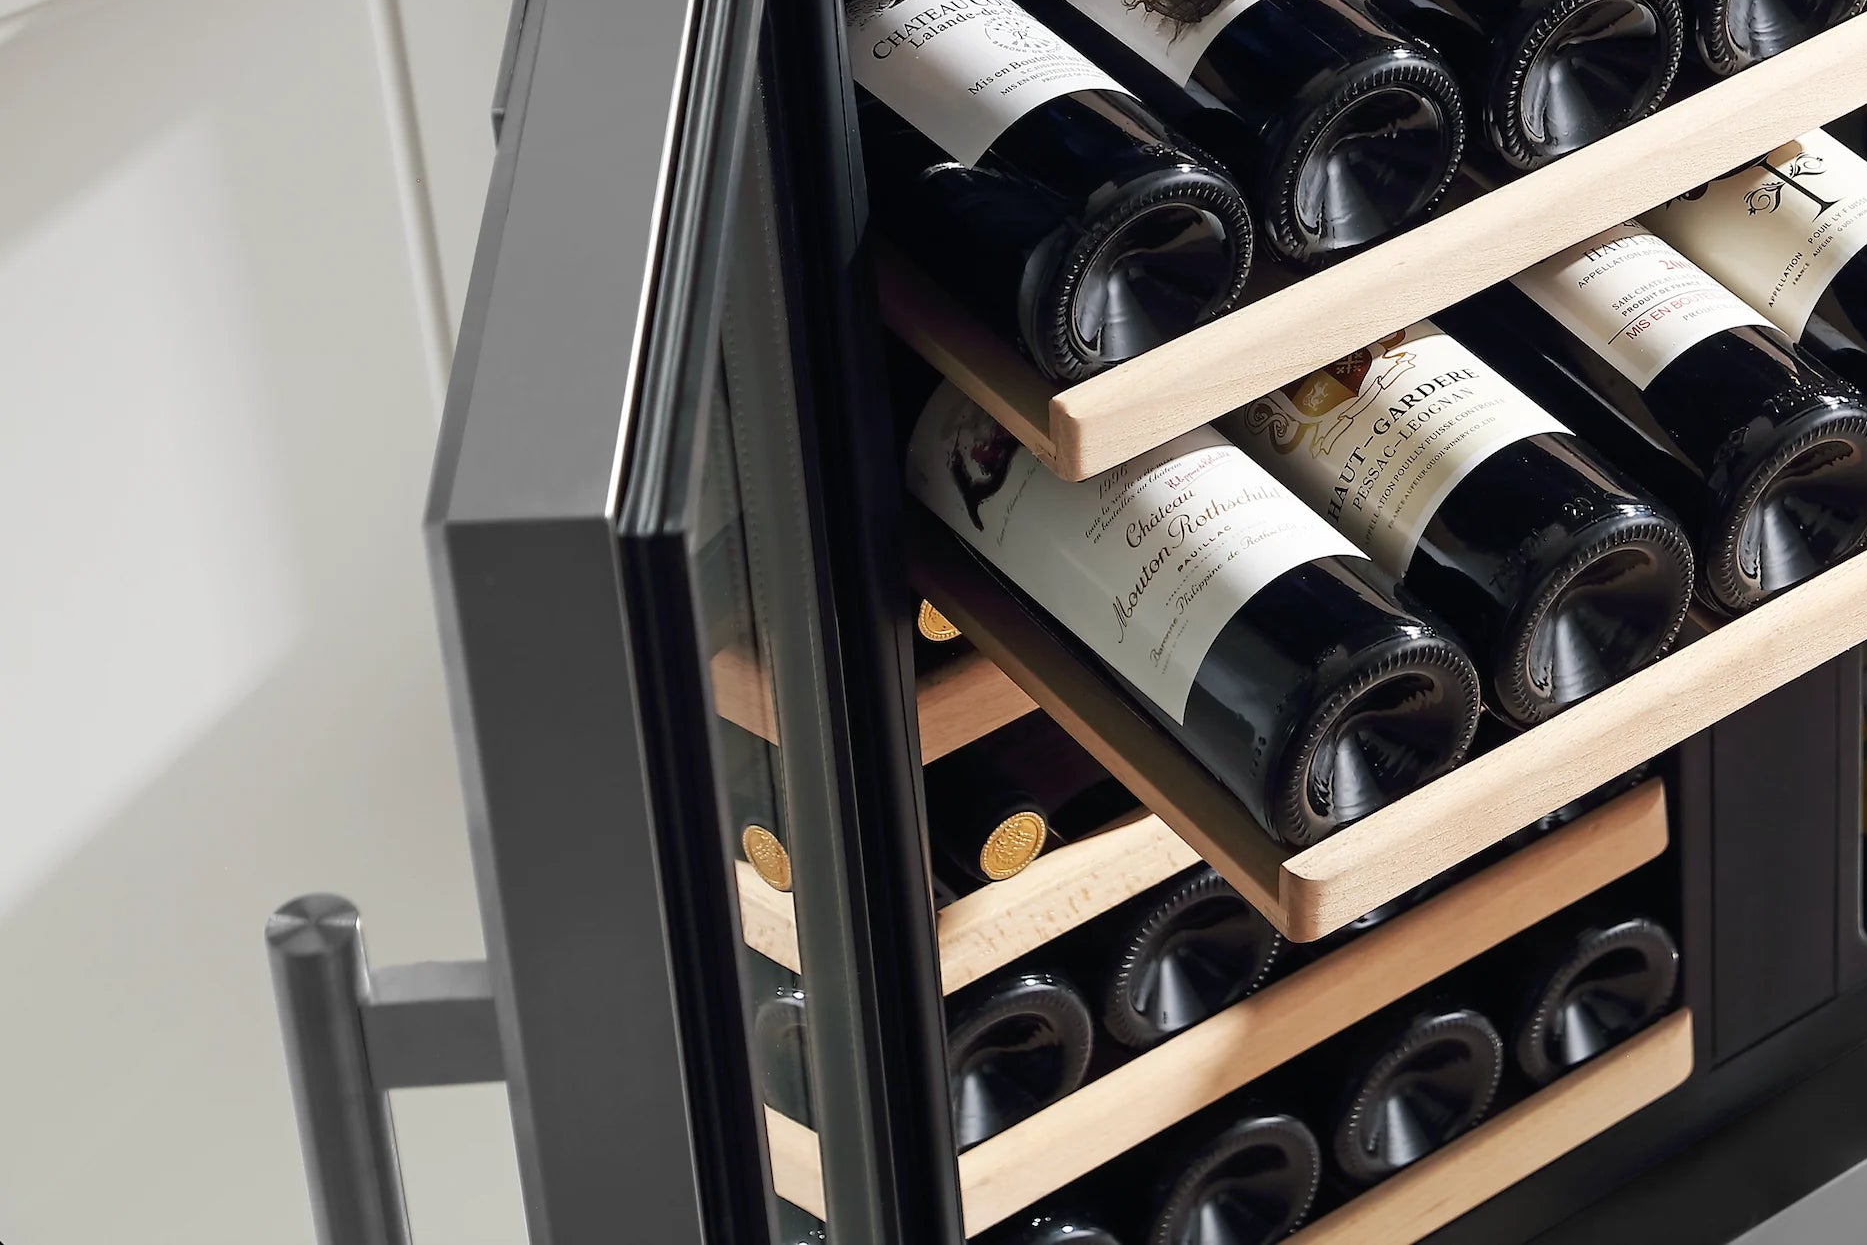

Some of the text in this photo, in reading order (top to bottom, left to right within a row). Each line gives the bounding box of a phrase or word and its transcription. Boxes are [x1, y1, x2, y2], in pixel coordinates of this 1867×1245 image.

[968, 75, 994, 96] Mis
[993, 67, 1010, 80] en
[1577, 251, 1643, 289] APPELLATION
[1768, 251, 1803, 308] APPELLATION
[1621, 291, 1660, 317] PRODUIT
[1625, 306, 1672, 340] MIS EN
[1443, 429, 1472, 454] WINERY
[1364, 478, 1397, 546] APPELLATION
[1393, 444, 1427, 484] POUILLY
[1424, 419, 1456, 450] FUISSE
[1124, 488, 1196, 548] Château
[1110, 544, 1172, 643] Mouton
[1165, 485, 1283, 550] Rothschild
[1177, 524, 1233, 573] PAUILLAC
[1149, 616, 1179, 668] Baronne
[1175, 561, 1224, 616] Philippine
[1226, 549, 1240, 563] de
